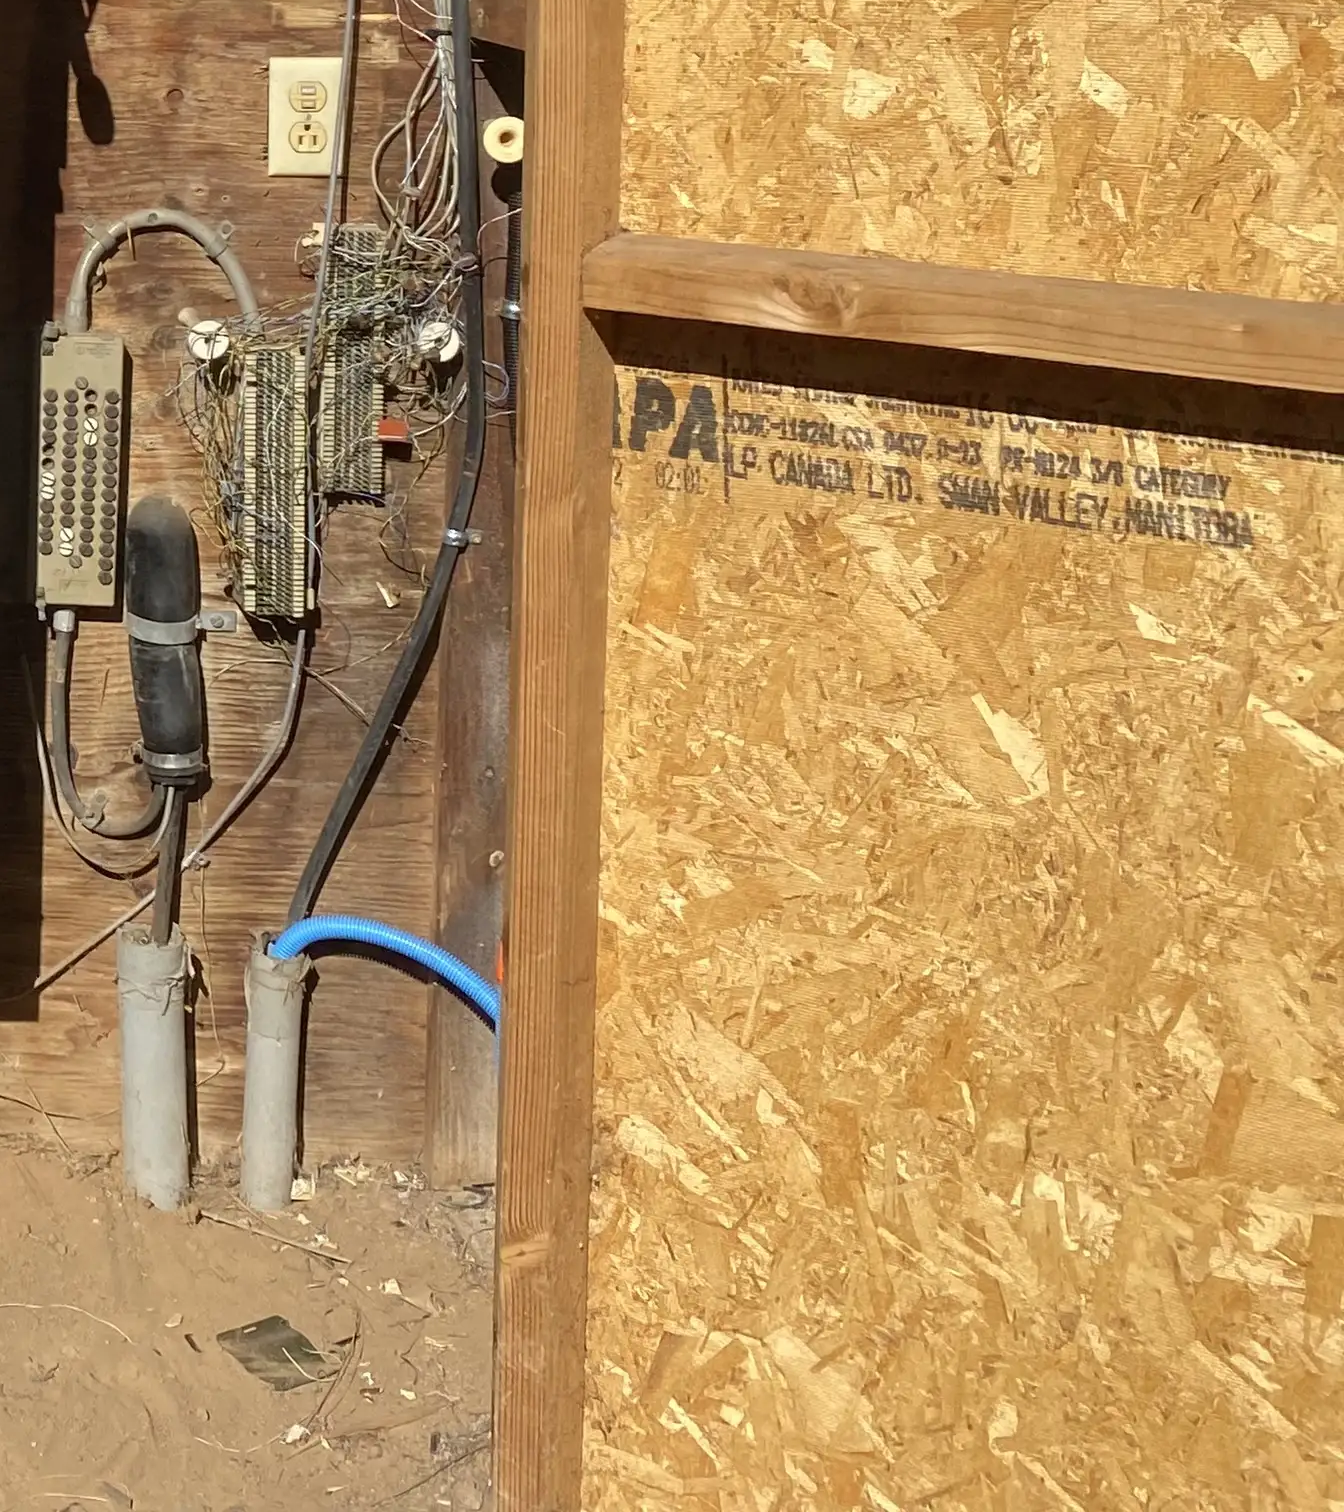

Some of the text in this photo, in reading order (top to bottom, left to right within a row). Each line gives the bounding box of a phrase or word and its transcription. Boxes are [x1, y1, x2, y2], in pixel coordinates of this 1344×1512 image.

[613, 374, 720, 462] PA
[769, 450, 855, 495] CANADA
[866, 459, 924, 505] LTD.
